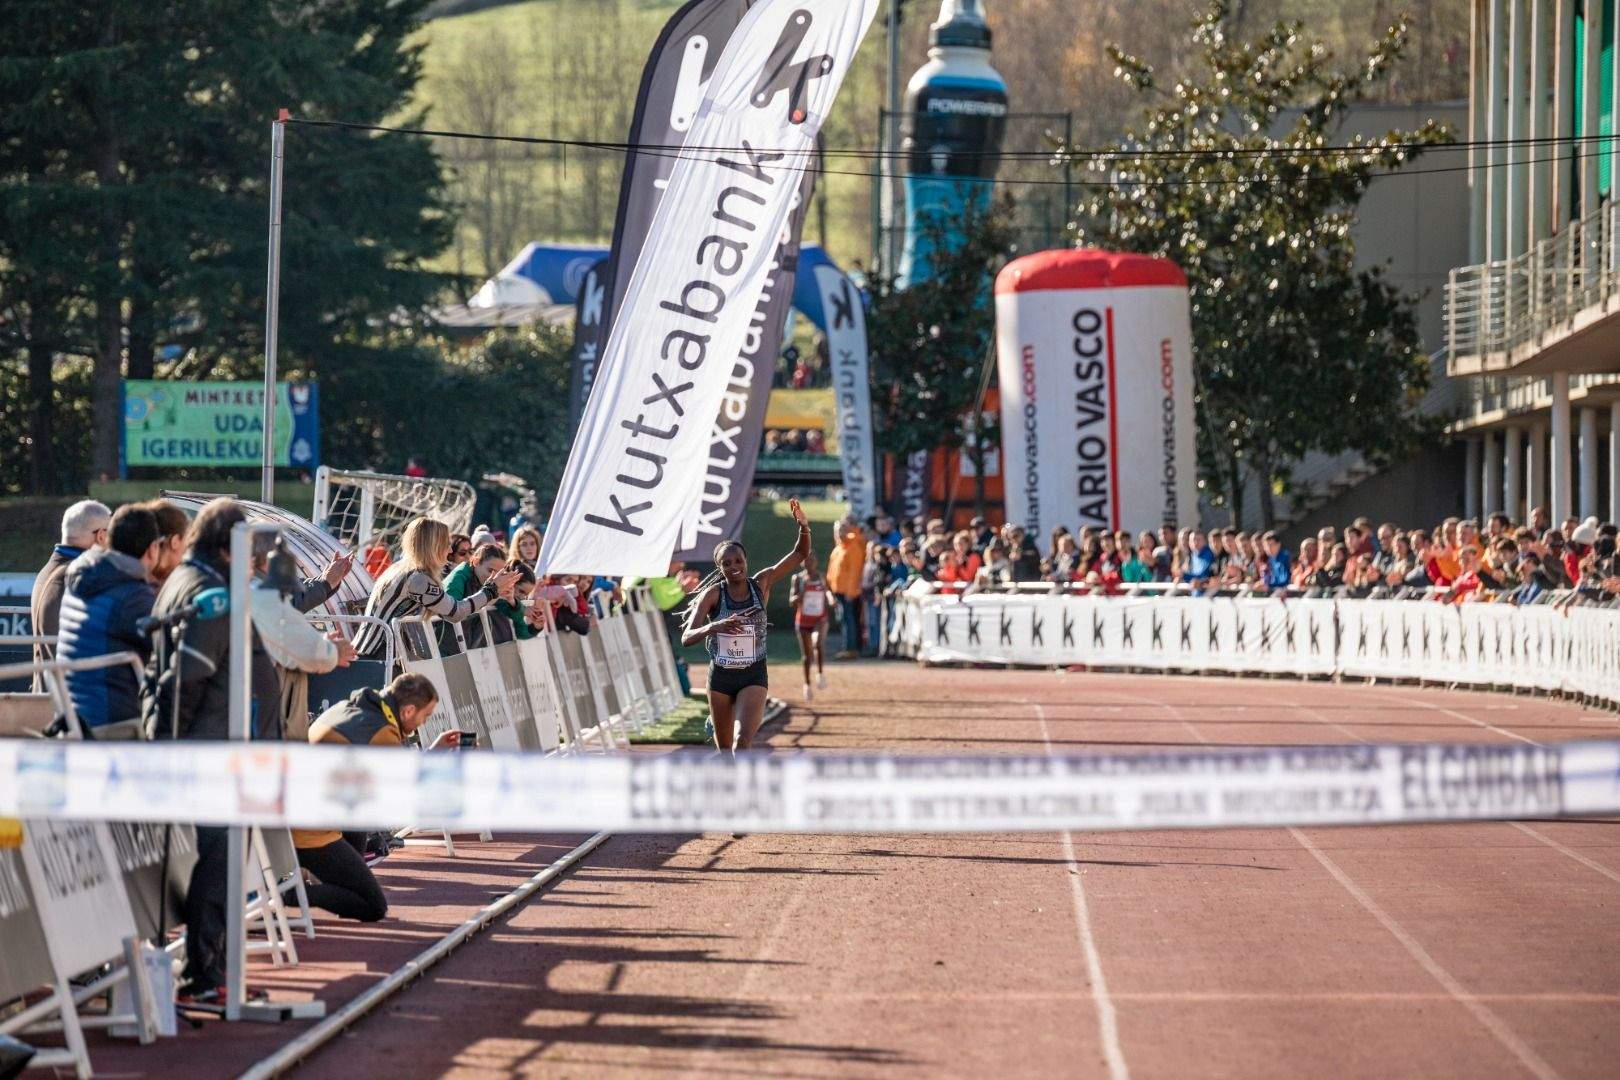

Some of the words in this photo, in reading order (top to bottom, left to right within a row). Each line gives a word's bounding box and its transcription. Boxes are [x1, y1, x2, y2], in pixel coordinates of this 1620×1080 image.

[584, 139, 785, 536] kutxabank
[1072, 307, 1106, 432] VASCO
[185, 389, 277, 406] MINTXET
[214, 413, 276, 434] UDA
[142, 438, 276, 459] IGERILEKU
